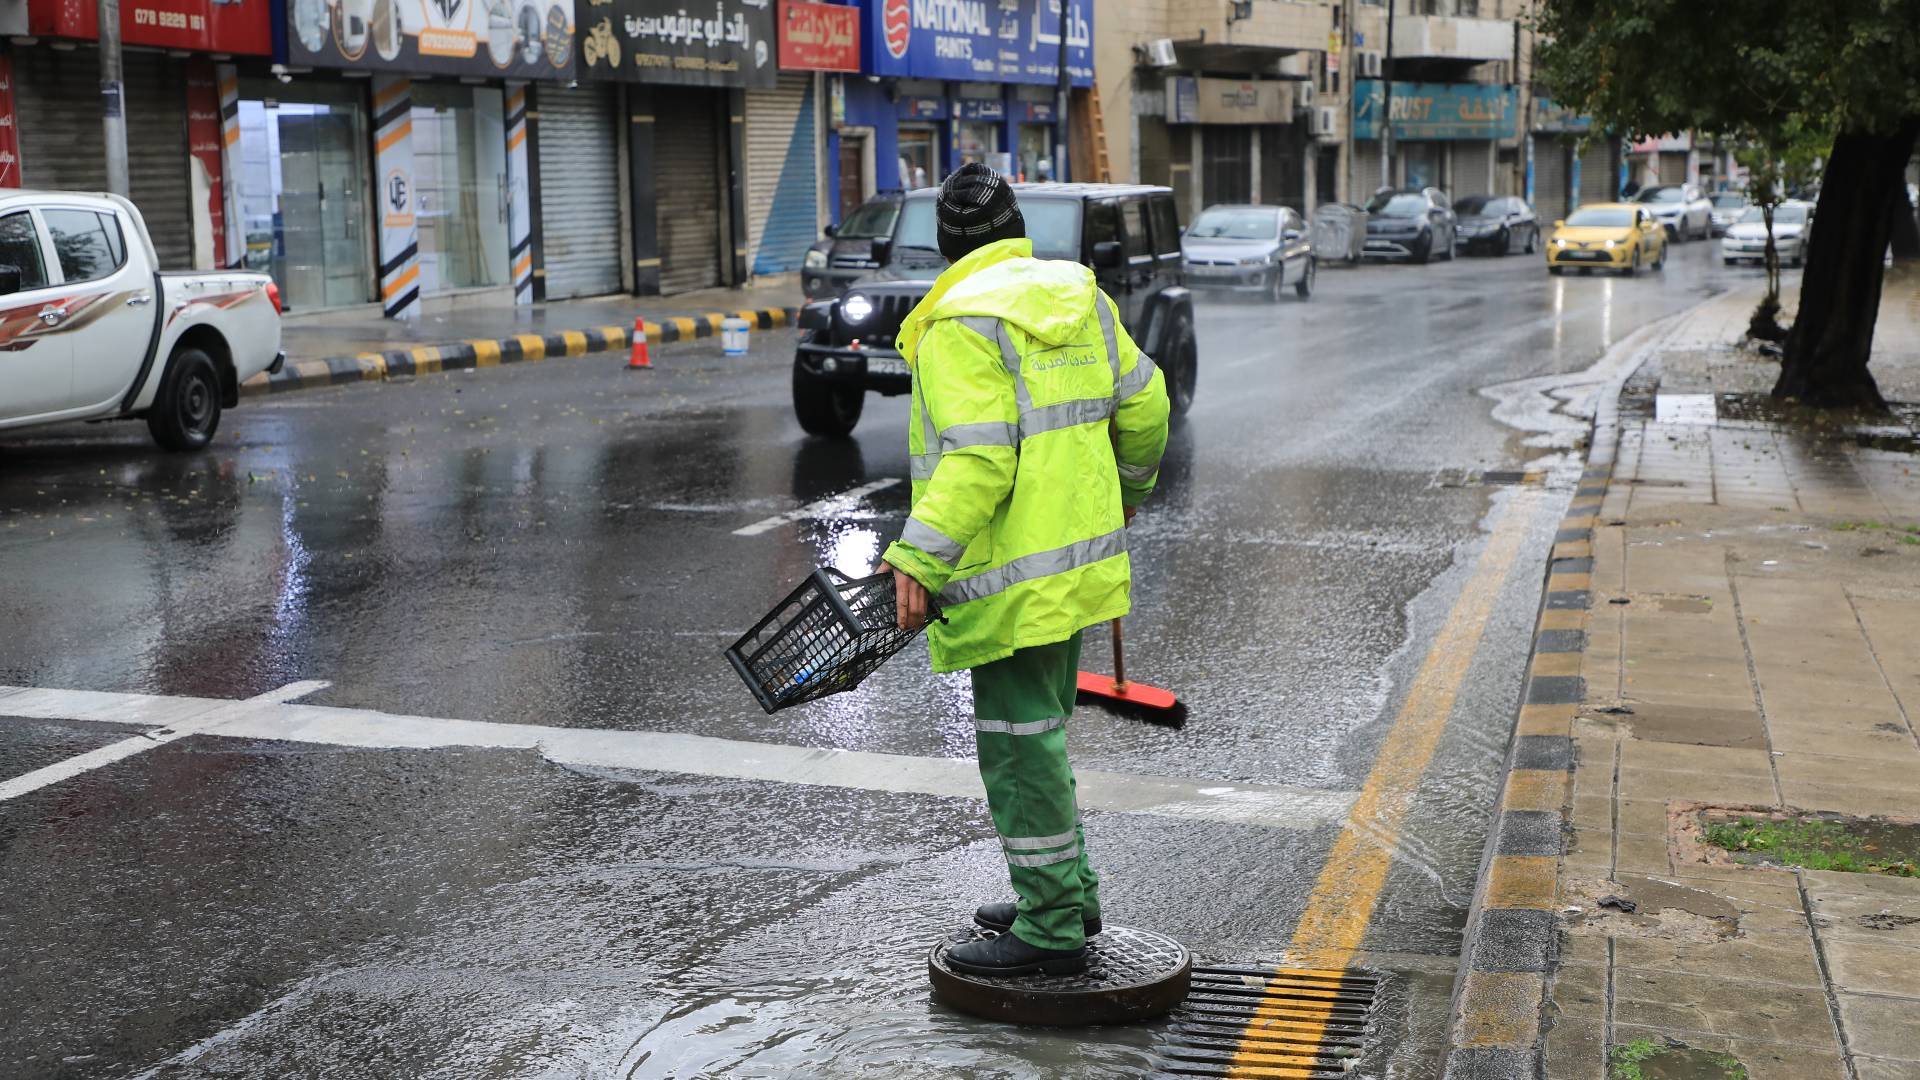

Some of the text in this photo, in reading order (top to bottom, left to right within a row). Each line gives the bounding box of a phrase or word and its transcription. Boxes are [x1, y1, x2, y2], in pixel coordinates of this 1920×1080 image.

[912, 0, 991, 36] NATIONAL
[935, 35, 973, 60] PAINTS
[1383, 95, 1434, 120] RUST
